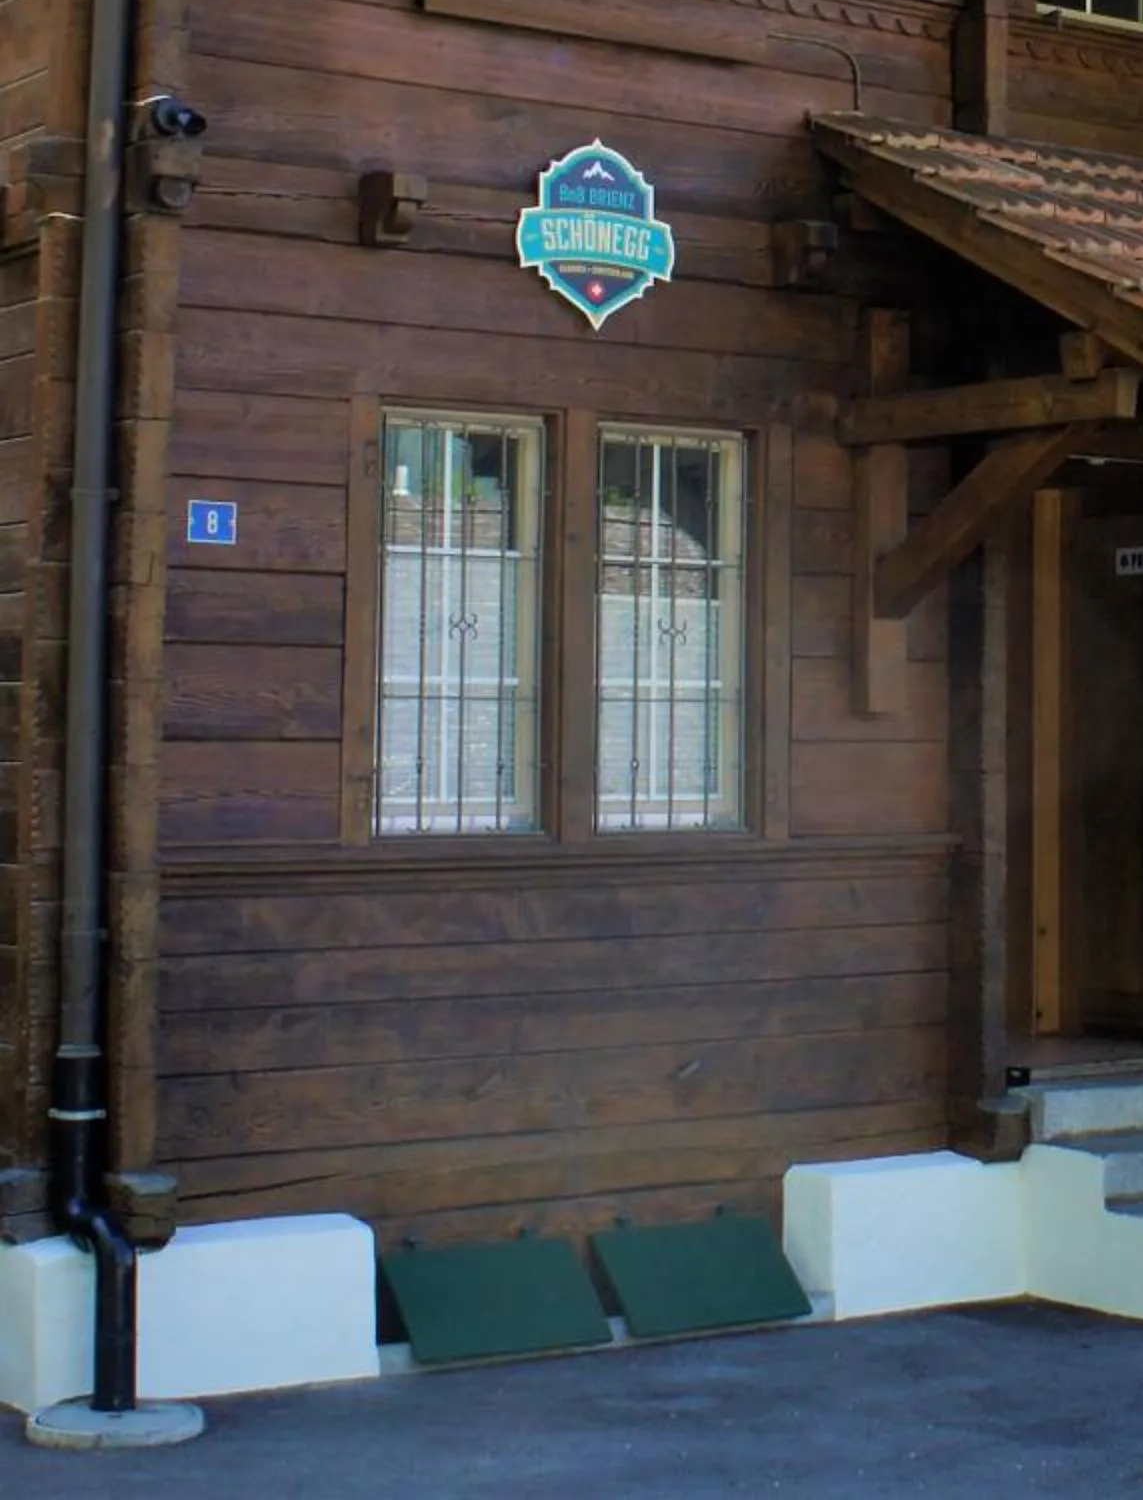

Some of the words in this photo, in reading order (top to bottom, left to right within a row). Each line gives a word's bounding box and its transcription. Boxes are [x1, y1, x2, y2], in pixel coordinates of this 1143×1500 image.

[589, 187, 636, 209] BRIENZ
[542, 211, 650, 260] SCHÖNEGG
[207, 510, 219, 534] 8
